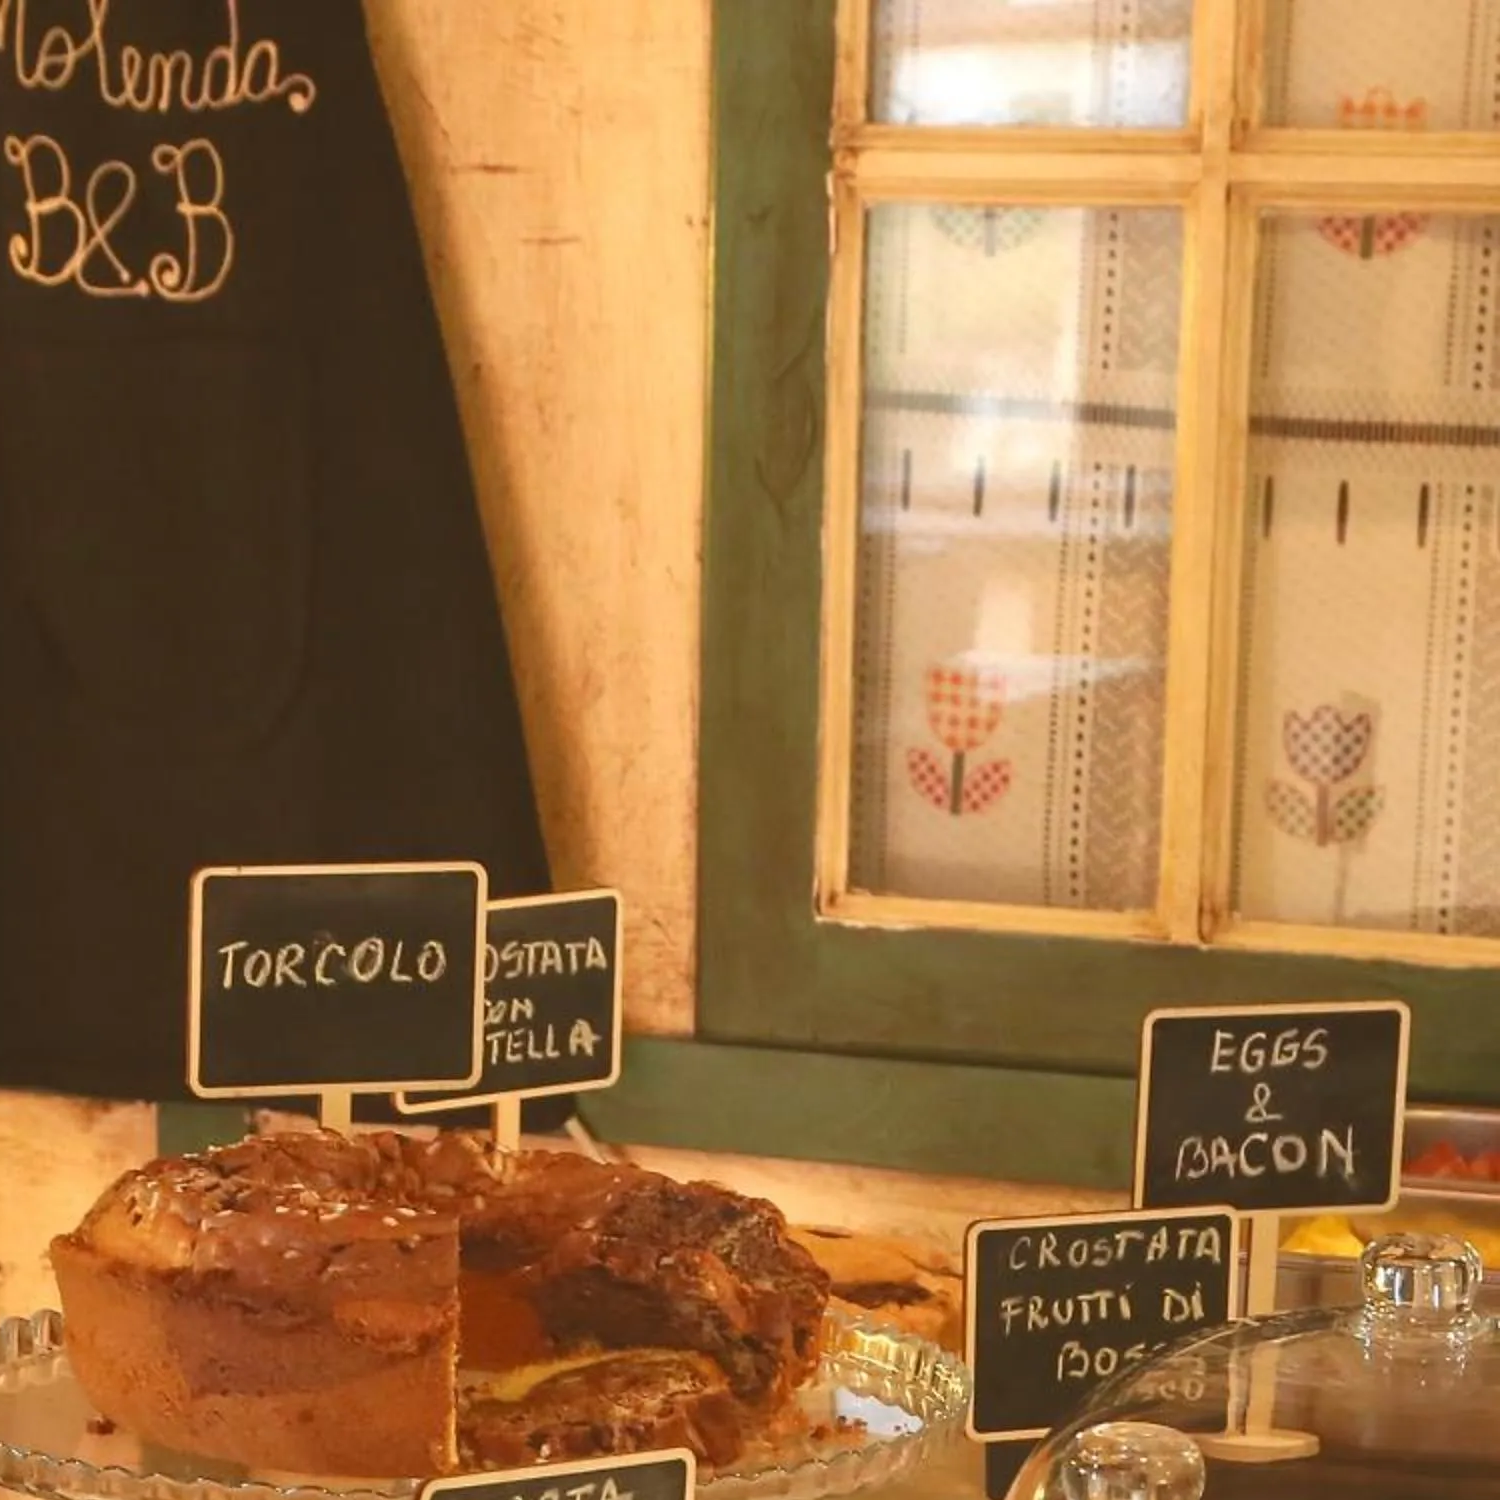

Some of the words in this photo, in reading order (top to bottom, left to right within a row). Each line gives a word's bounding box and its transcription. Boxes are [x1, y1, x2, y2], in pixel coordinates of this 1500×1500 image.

[4, 135, 234, 301] B&B
[217, 937, 447, 990] TORCOLO
[484, 937, 607, 983] OSTATA
[485, 1018, 603, 1066] TELLA
[1210, 1028, 1330, 1074] EGGS
[1244, 1082, 1284, 1122] &
[1175, 1125, 1357, 1182] BACON
[1008, 1226, 1222, 1271] CROSTATA
